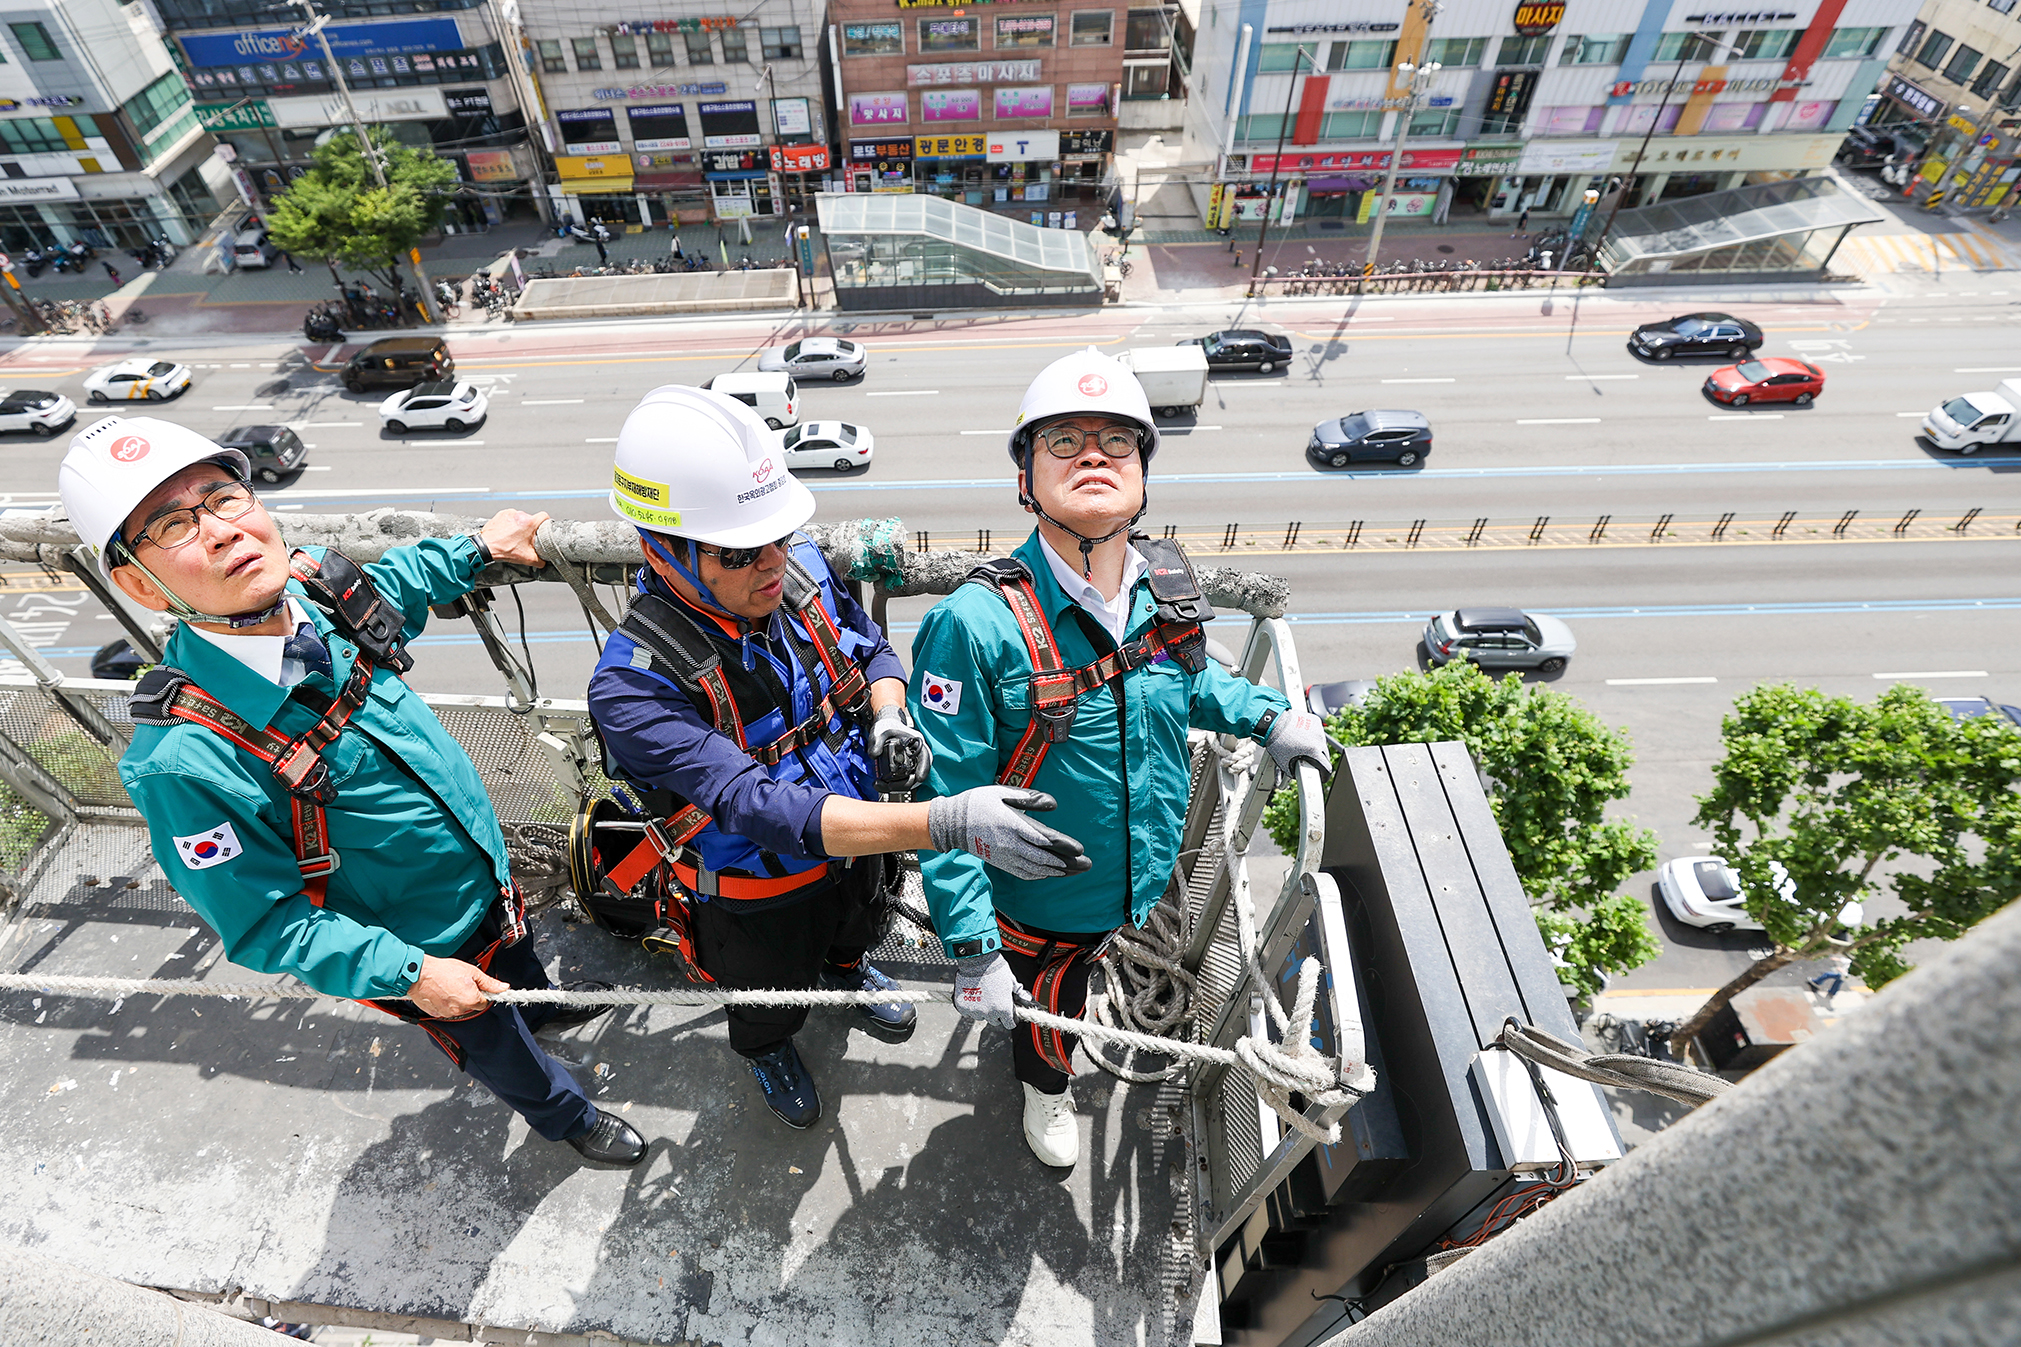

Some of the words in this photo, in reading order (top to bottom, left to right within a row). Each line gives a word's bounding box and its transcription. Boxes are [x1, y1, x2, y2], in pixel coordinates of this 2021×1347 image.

[1515, 6, 1565, 25] 마사지
[916, 63, 1036, 84] 스포츠마사지
[863, 107, 902, 120] 맛사지
[853, 144, 910, 157] 로또부동산
[920, 138, 984, 154] 광문안경
[784, 153, 825, 168] 노래방
[1031, 625, 1049, 650] K2
[219, 712, 250, 736] K2
[684, 811, 704, 826] K2
[304, 830, 318, 851] K2
